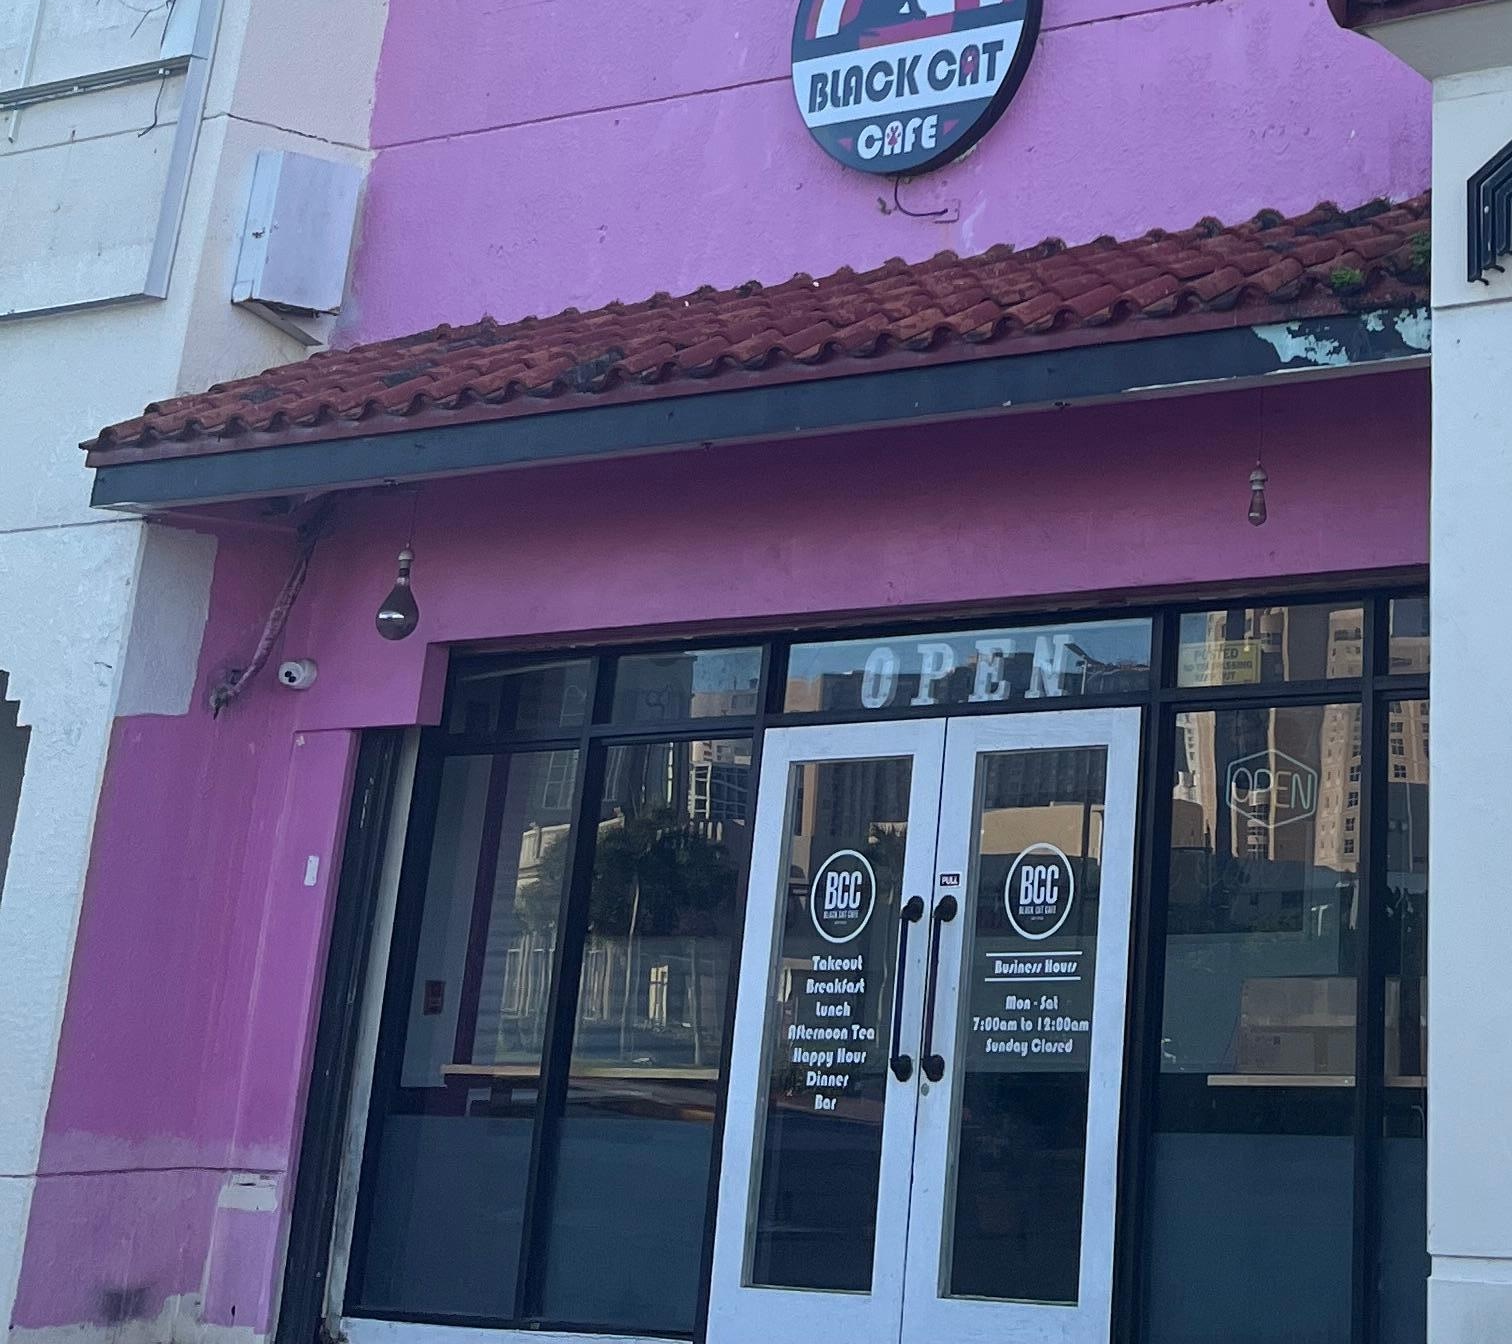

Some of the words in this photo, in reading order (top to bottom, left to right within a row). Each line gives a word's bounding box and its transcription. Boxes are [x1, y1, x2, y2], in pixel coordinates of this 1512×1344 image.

[808, 54, 922, 113] BLACK
[927, 39, 1004, 91] CAT
[857, 114, 938, 160] CAFE
[861, 634, 1076, 709] OPEN
[1232, 767, 1312, 810] OPEN
[824, 871, 863, 909] BCC
[1019, 864, 1060, 904] BCC
[812, 955, 863, 971] Takeout
[994, 959, 1042, 974] Business
[1044, 959, 1077, 973] Hours
[806, 978, 865, 993] Breakfast
[816, 1001, 851, 1017] Lunch
[1005, 995, 1031, 1010] Mon
[1040, 995, 1058, 1010] Sat
[788, 1025, 848, 1041] Afternoon
[851, 1024, 875, 1040] Tea
[973, 1016, 1018, 1031] 7:00am
[1020, 1016, 1033, 1031] to
[1037, 1016, 1090, 1032] 12:00am
[985, 1038, 1028, 1057] Sunday
[1031, 1038, 1073, 1053] Closed
[793, 1047, 834, 1067] Happy
[836, 1047, 866, 1063] Hour
[806, 1071, 849, 1087] Dinner
[814, 1094, 837, 1110] Bar
